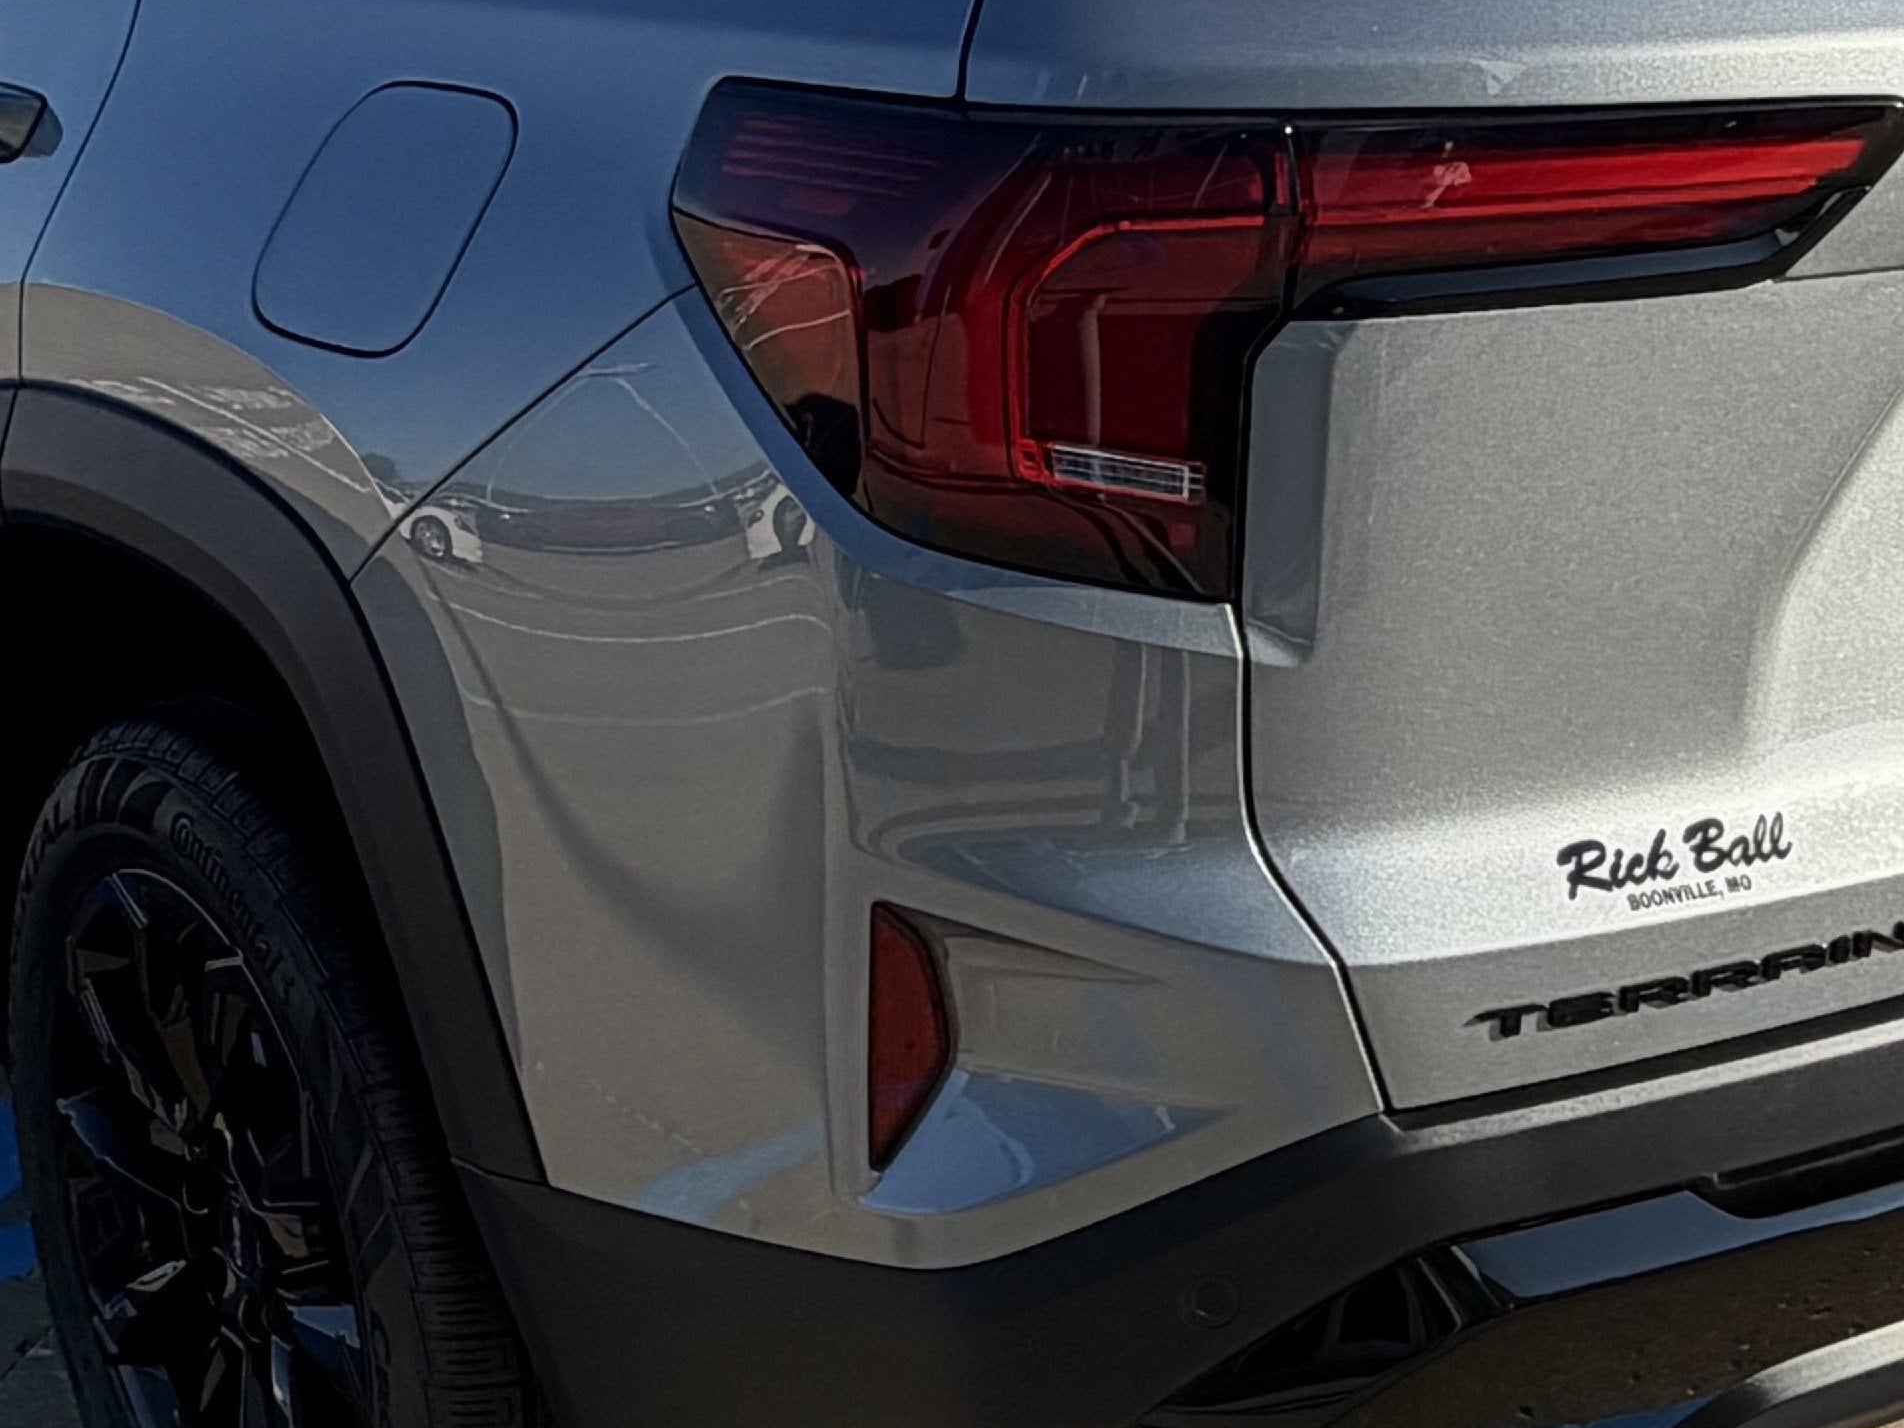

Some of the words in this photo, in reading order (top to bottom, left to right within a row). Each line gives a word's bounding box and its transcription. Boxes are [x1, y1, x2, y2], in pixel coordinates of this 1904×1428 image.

[1556, 828, 1680, 901] Rick
[1682, 811, 1793, 873] Ball
[1627, 879, 1725, 912] BOONVILLE,
[1727, 874, 1752, 893] MO
